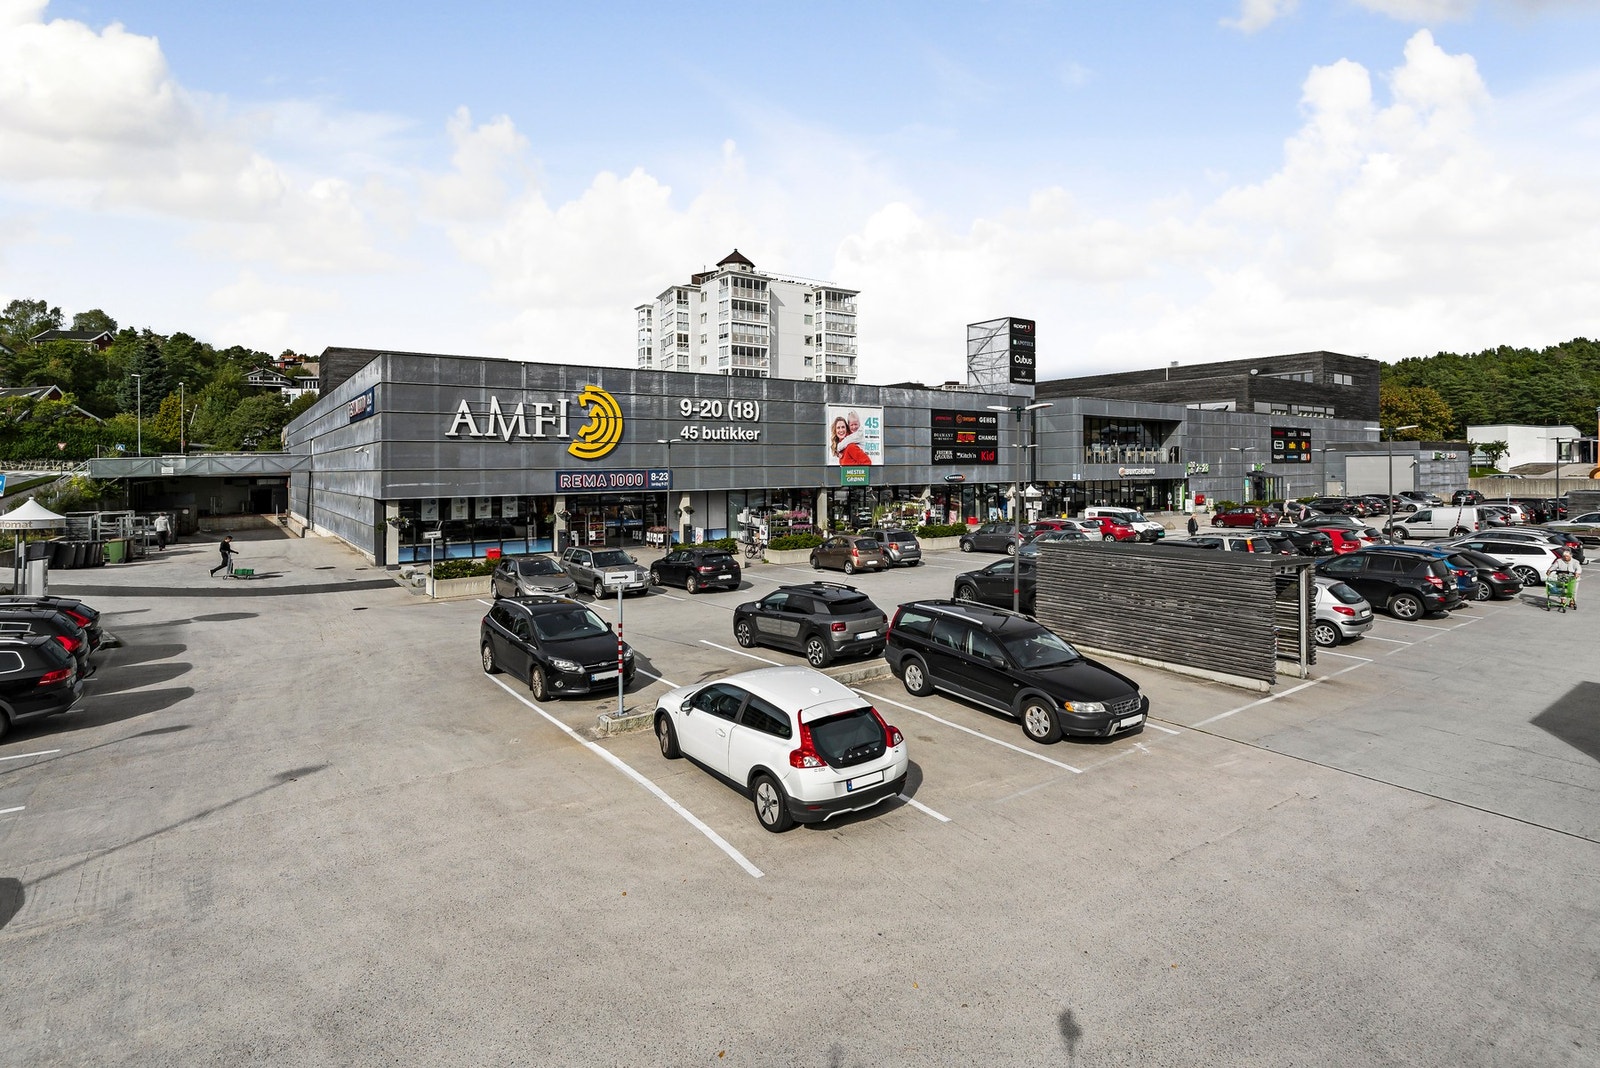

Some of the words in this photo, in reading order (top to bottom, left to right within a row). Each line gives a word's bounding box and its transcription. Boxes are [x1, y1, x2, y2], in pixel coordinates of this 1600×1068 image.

[1014, 354, 1033, 365] Cubus
[680, 398, 723, 418] 9-20
[727, 399, 760, 422] (18)
[444, 395, 570, 441] AMFI
[864, 416, 879, 429] 45
[680, 425, 699, 440] 45
[702, 425, 760, 440] butikker
[981, 450, 995, 461] Kid
[560, 474, 607, 488] REMA
[609, 473, 644, 487] 1000
[650, 472, 669, 481] 8-23
